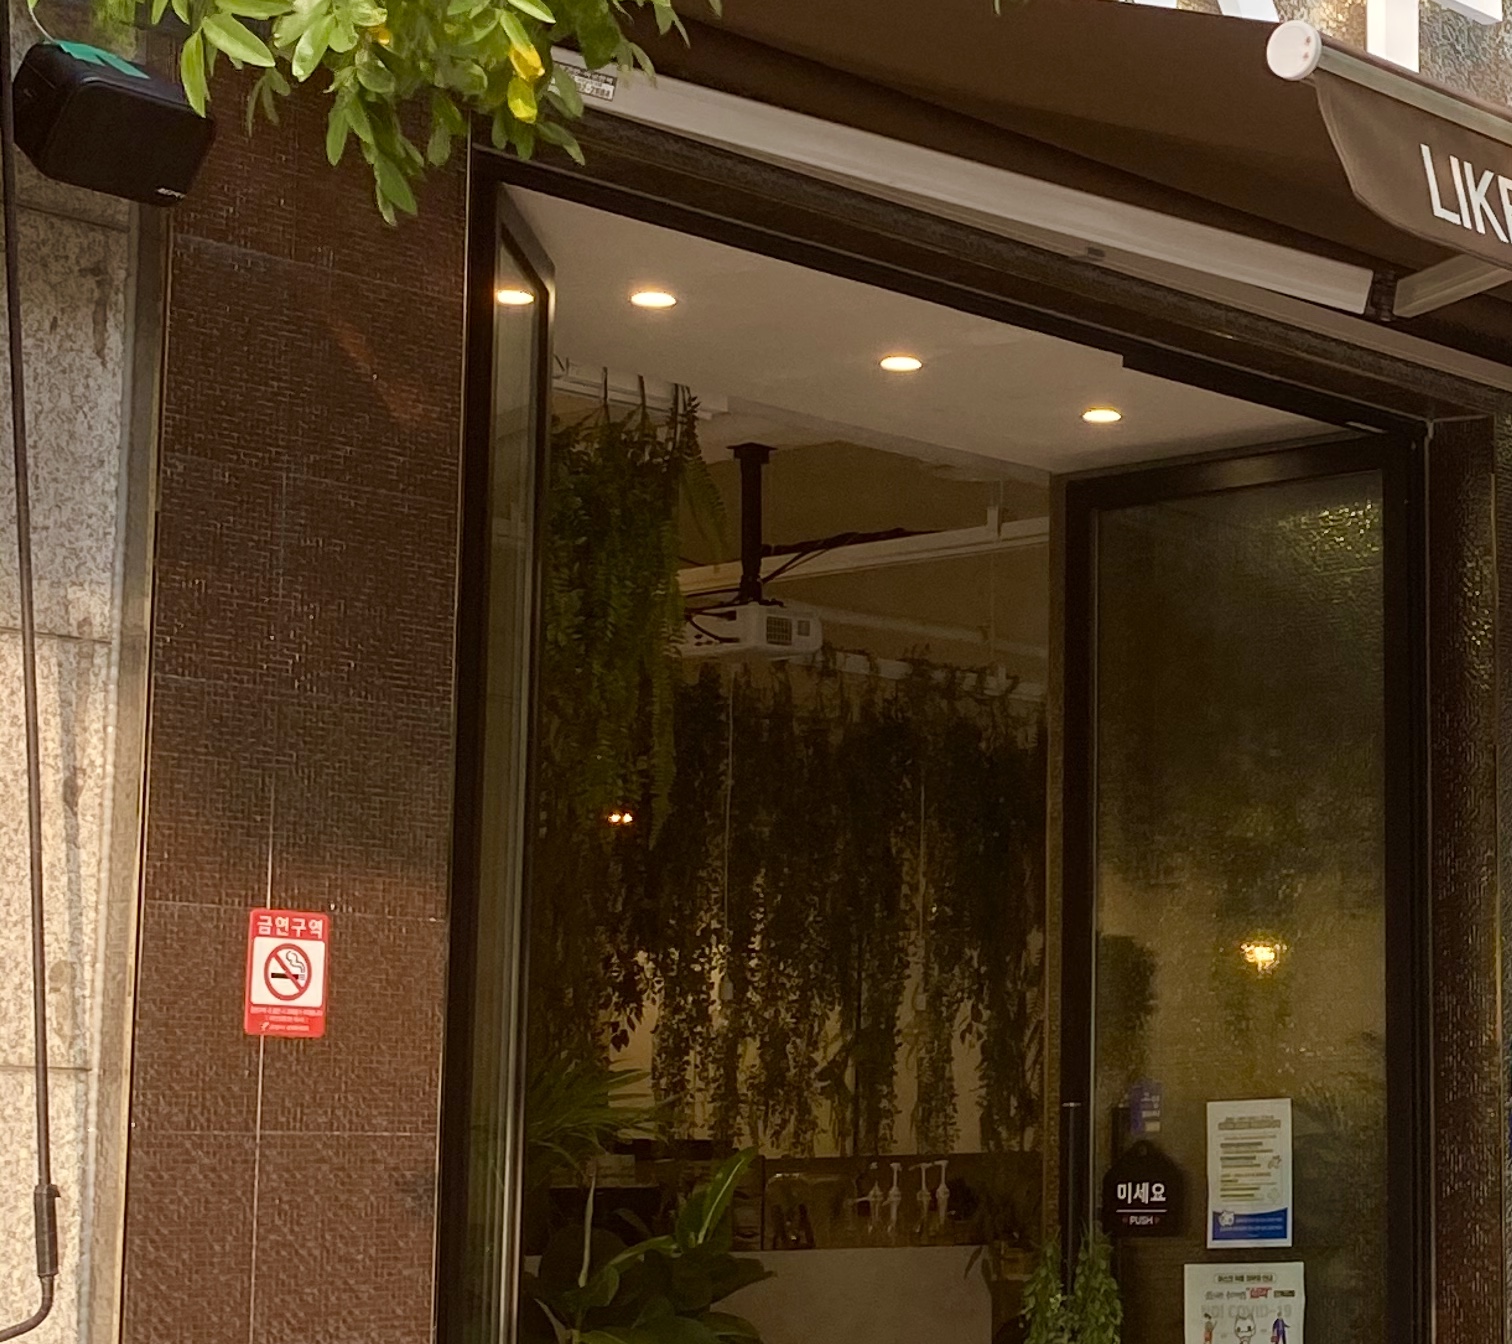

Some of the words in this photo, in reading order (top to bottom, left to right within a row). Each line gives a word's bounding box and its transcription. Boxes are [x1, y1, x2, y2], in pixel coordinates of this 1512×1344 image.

[257, 915, 324, 940] 금연구역
[1116, 1181, 1167, 1205] 미세요
[1128, 1215, 1154, 1226] PUSH
